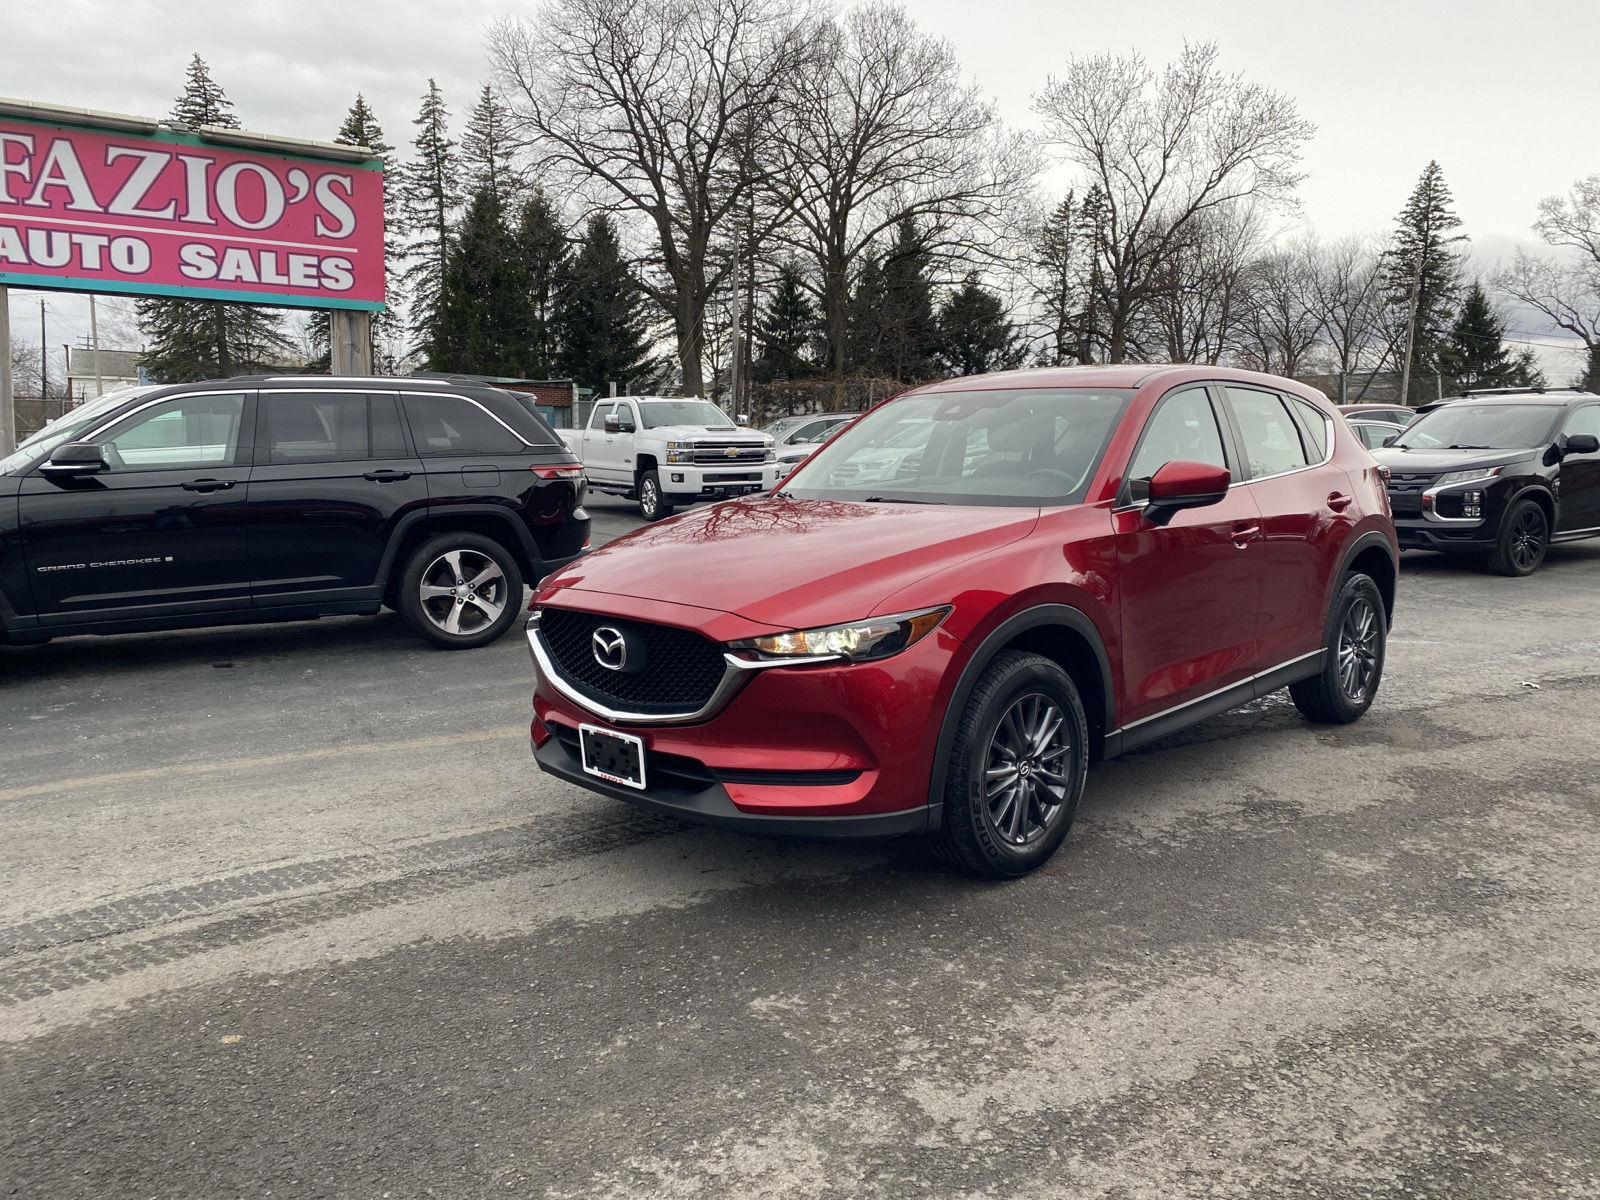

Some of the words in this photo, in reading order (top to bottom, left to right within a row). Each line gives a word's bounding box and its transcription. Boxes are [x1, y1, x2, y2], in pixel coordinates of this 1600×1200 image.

[0, 131, 357, 240] FAZIO'S
[0, 225, 152, 275] AUTO
[179, 242, 356, 292] SALES
[37, 563, 86, 572] GRAND
[89, 557, 162, 568] CHEROKEE
[971, 780, 1001, 861] OOPER
